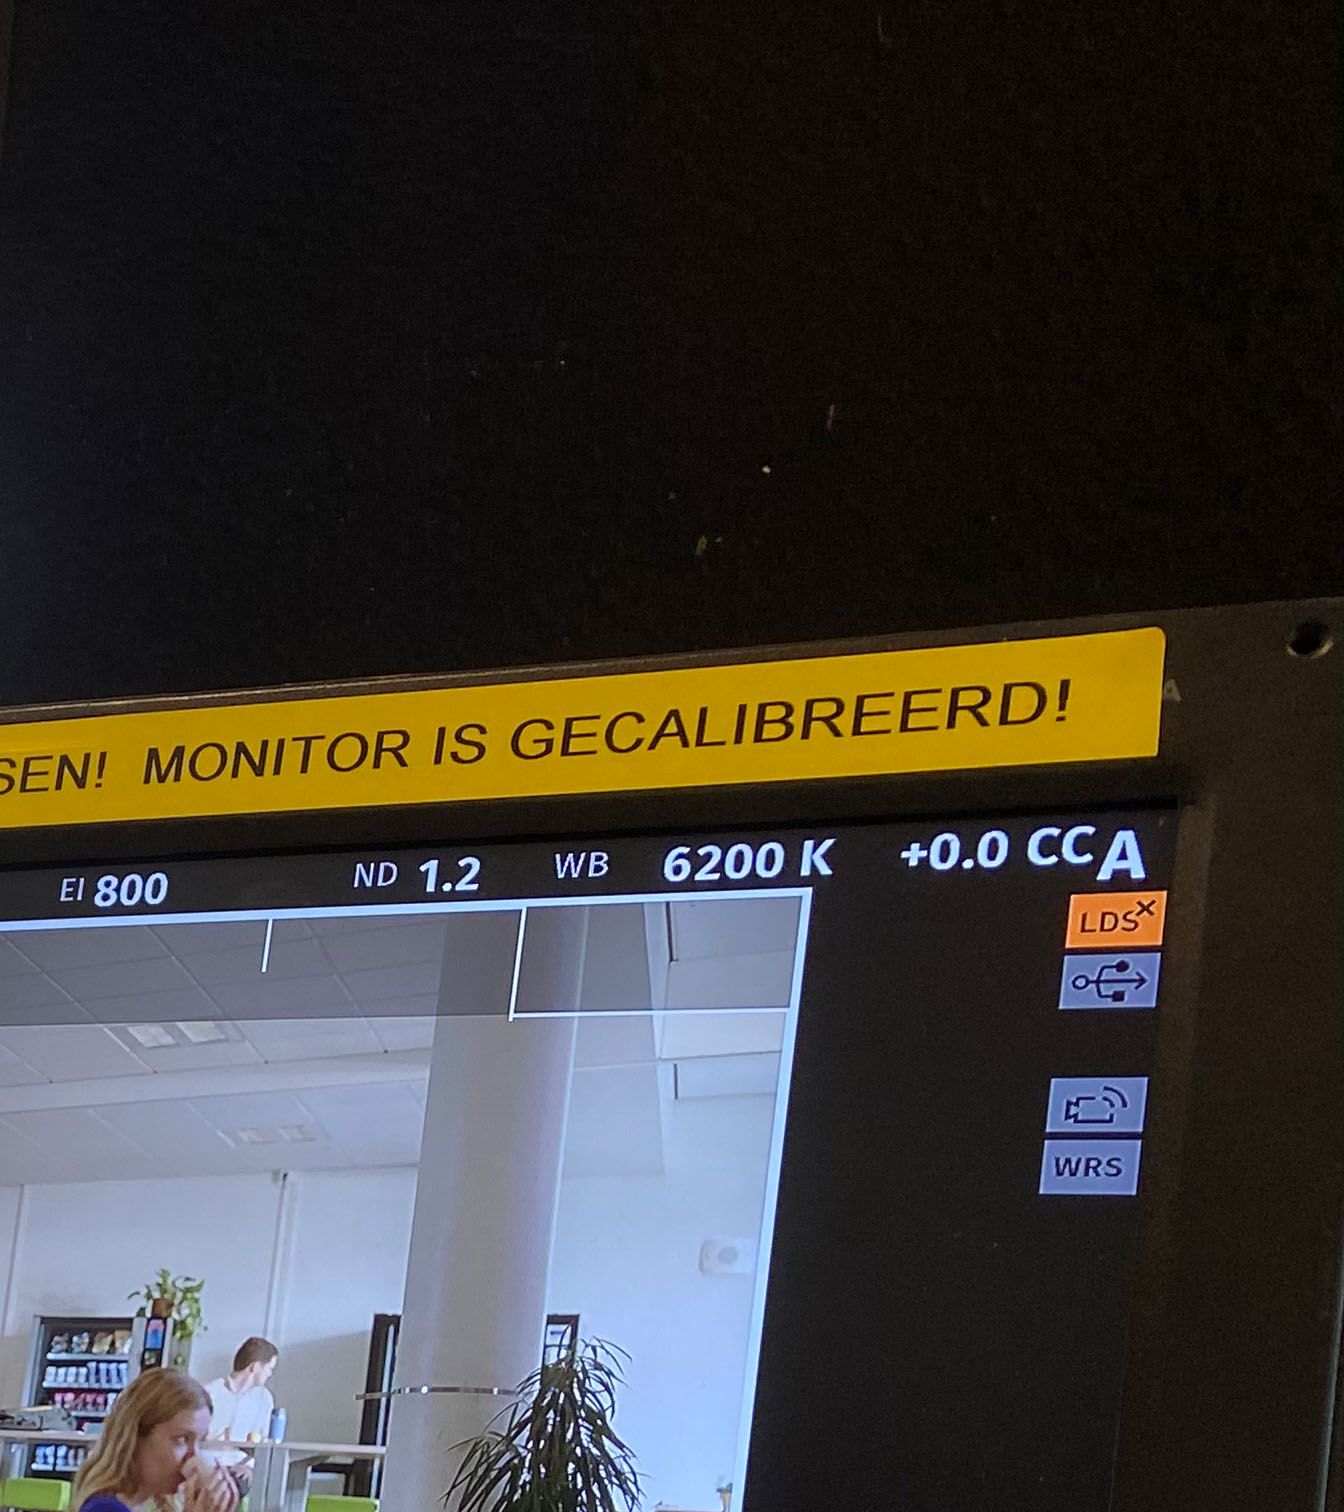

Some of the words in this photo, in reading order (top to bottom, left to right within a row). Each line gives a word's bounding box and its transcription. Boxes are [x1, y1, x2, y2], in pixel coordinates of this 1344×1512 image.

[143, 729, 410, 784] MONITOR
[434, 723, 488, 764] IS
[510, 678, 1072, 760] GECALIBREERD!
[555, 851, 609, 880] WB
[662, 840, 785, 884] 6200
[801, 837, 837, 877] K
[901, 830, 1009, 871] +0.0
[1027, 825, 1097, 867] CC
[1096, 830, 1146, 880] A
[59, 876, 85, 901] EI
[94, 872, 168, 908] 800
[353, 861, 398, 889] ND
[417, 856, 481, 894] 1.2
[1055, 1156, 1123, 1177] WRS
